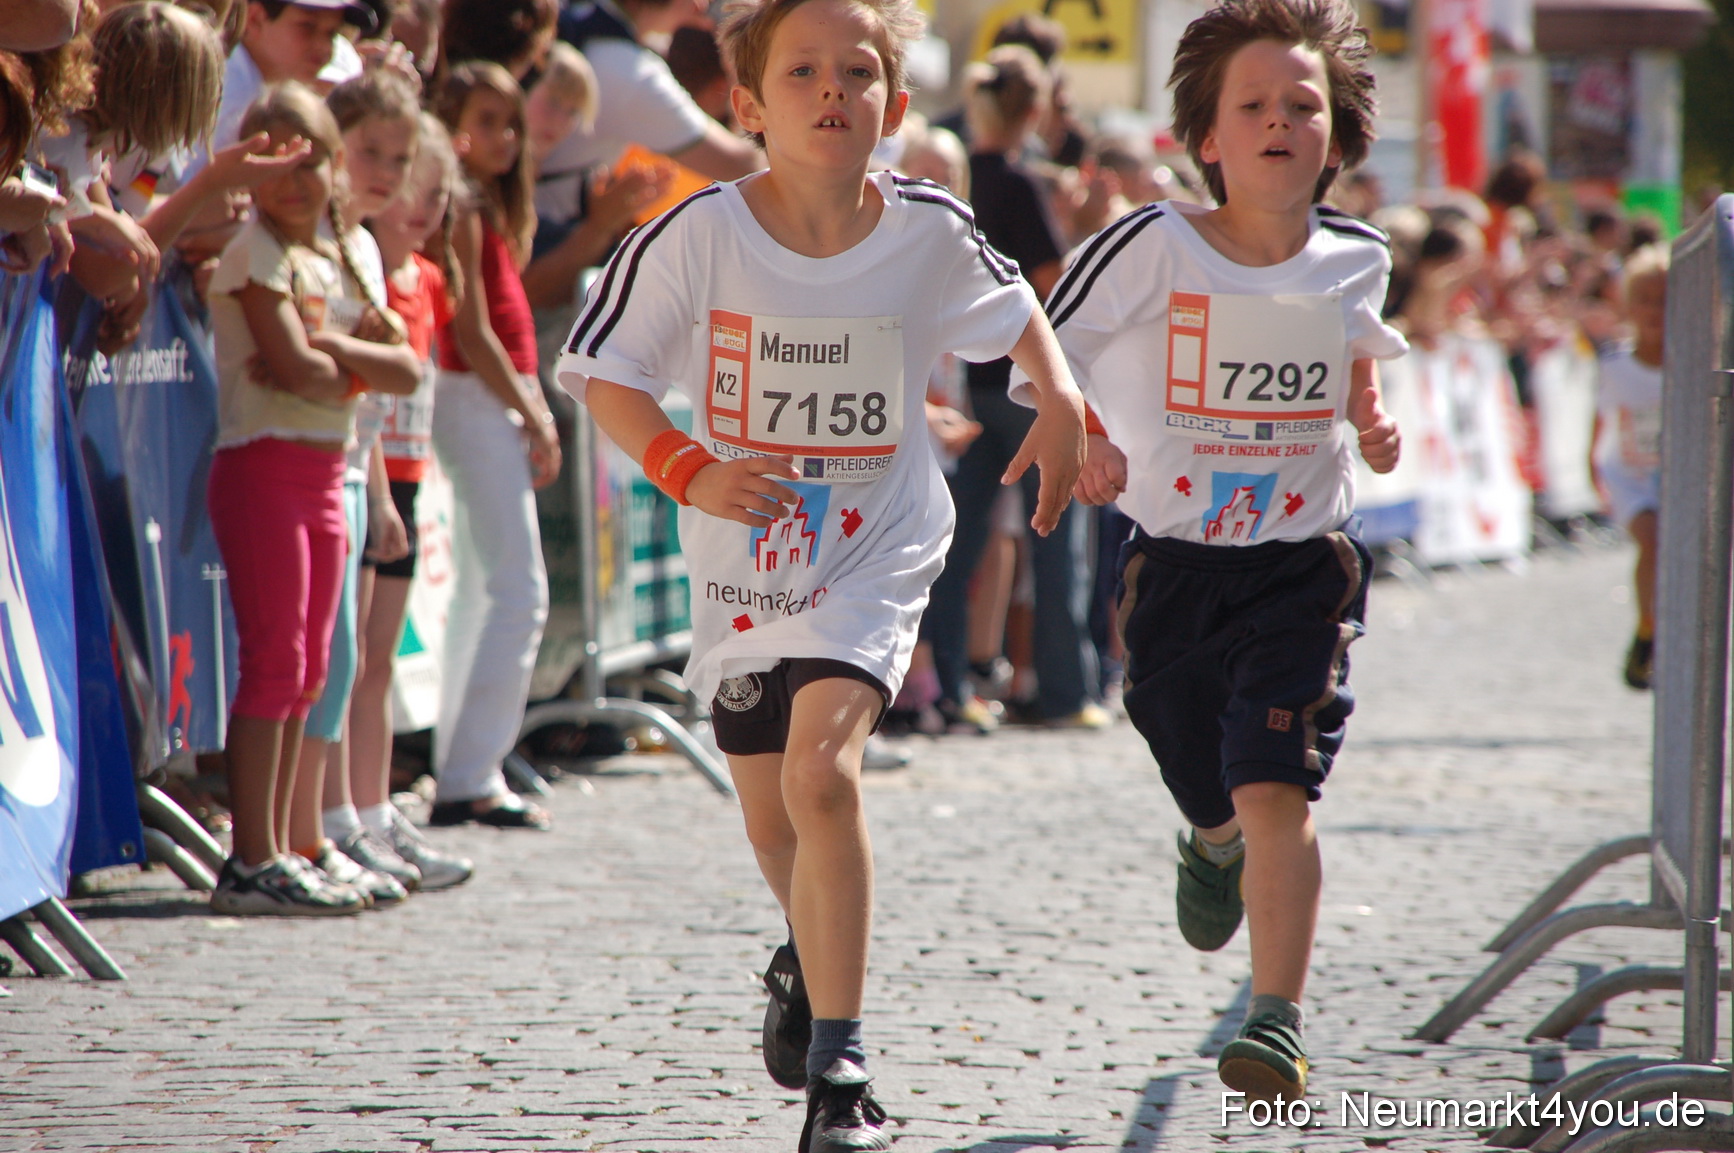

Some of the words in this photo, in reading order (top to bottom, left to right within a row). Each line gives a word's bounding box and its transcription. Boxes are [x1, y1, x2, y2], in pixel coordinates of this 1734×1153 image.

[760, 331, 850, 364] Manuel
[715, 371, 737, 396] K2
[1219, 361, 1329, 401] 7292
[762, 390, 887, 436] 7158
[1166, 413, 1232, 433] BOCK
[1275, 419, 1333, 434] PFLEIDERER
[1193, 443, 1225, 456] JEDER
[1228, 444, 1282, 457] EINZELNE
[1285, 442, 1318, 457] ZÄHLT
[706, 580, 808, 616] neumakt
